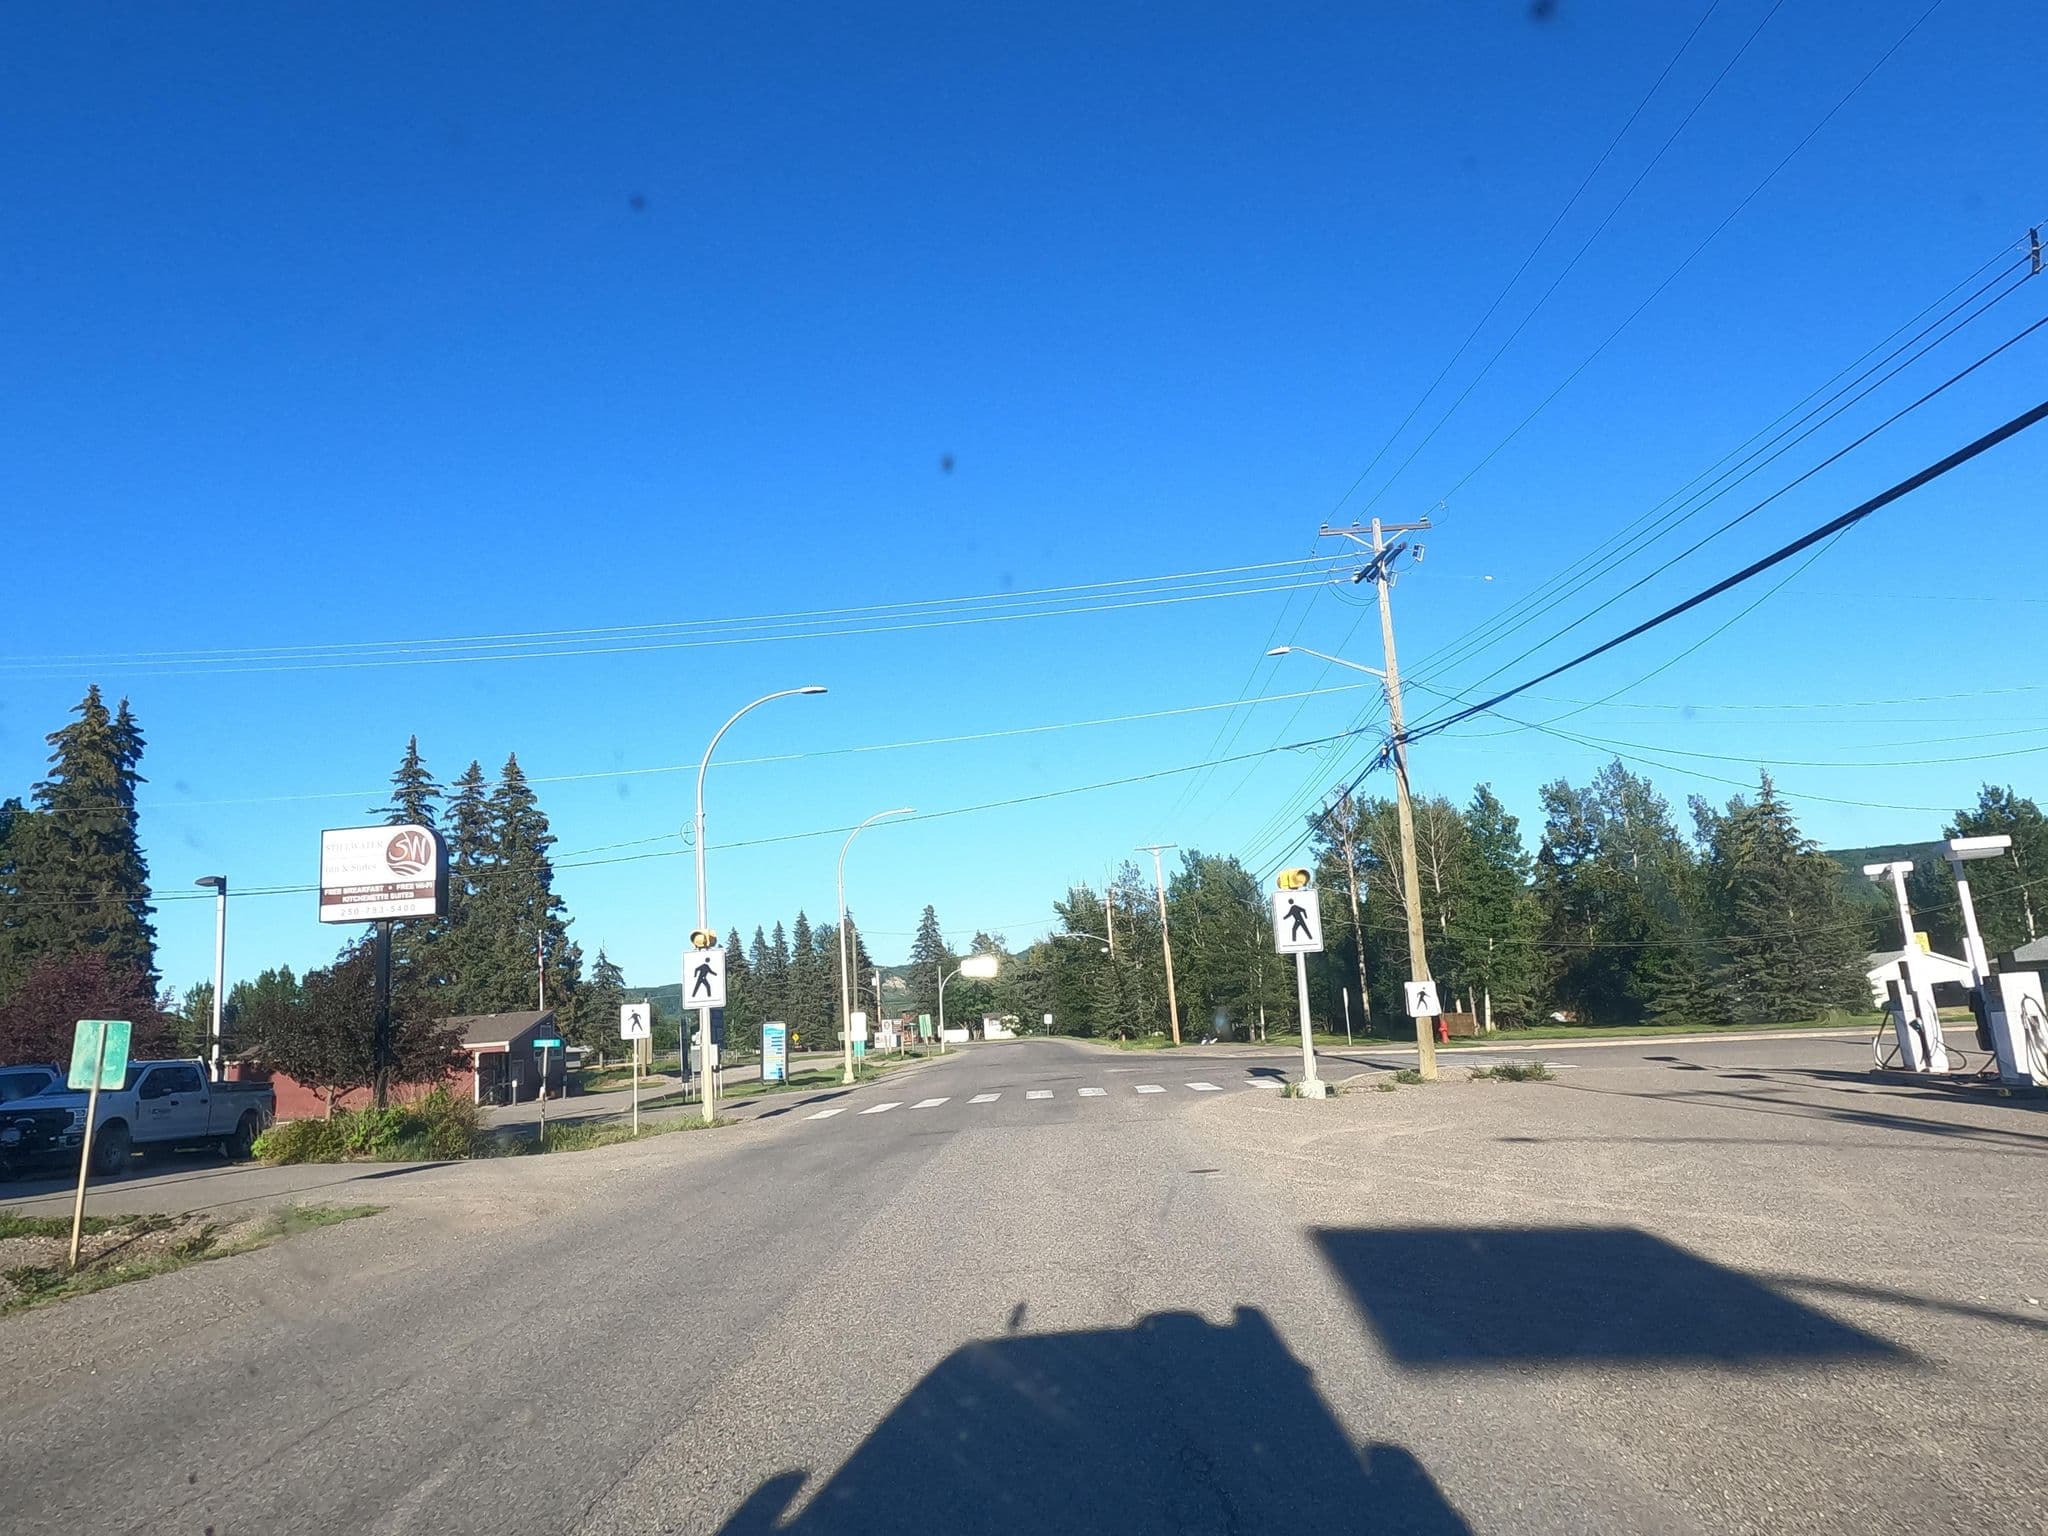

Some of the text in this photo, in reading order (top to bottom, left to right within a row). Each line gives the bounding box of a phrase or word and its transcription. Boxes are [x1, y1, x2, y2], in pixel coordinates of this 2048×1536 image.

[324, 888, 342, 896] FREE
[343, 885, 384, 894] BREAKFAST
[396, 882, 415, 890] FREE
[390, 891, 414, 900] SUITES
